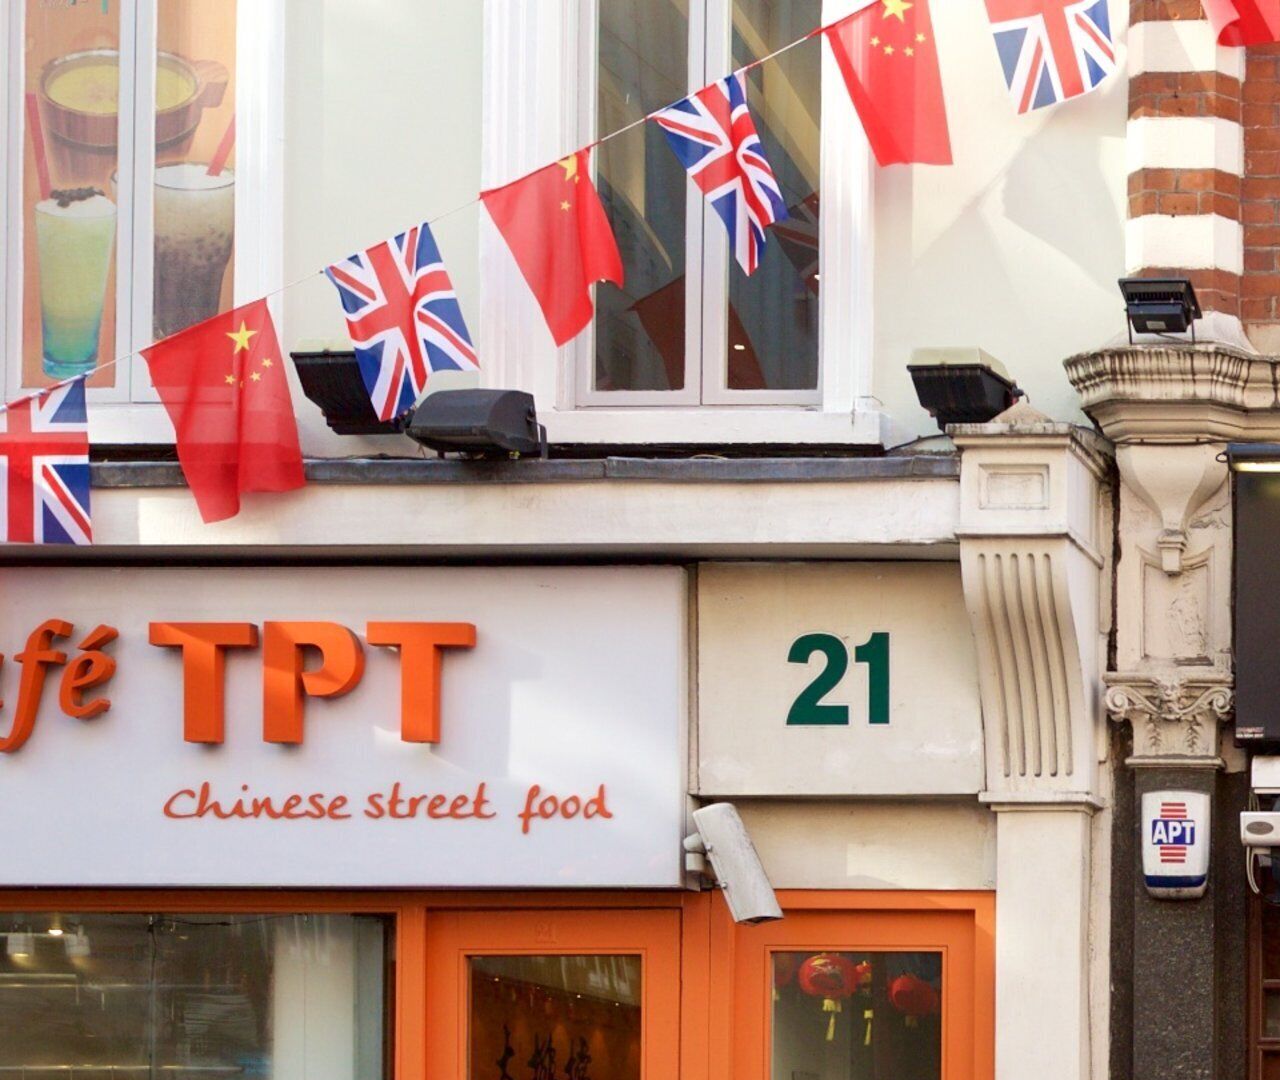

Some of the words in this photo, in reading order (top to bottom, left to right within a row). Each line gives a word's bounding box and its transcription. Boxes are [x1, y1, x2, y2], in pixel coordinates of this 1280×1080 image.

[0, 618, 119, 754] fé
[148, 620, 477, 745] TPT
[785, 632, 890, 726] 21
[162, 781, 352, 820] Chinese
[364, 782, 497, 820] street
[517, 783, 614, 834] food
[1151, 819, 1196, 845] APT
